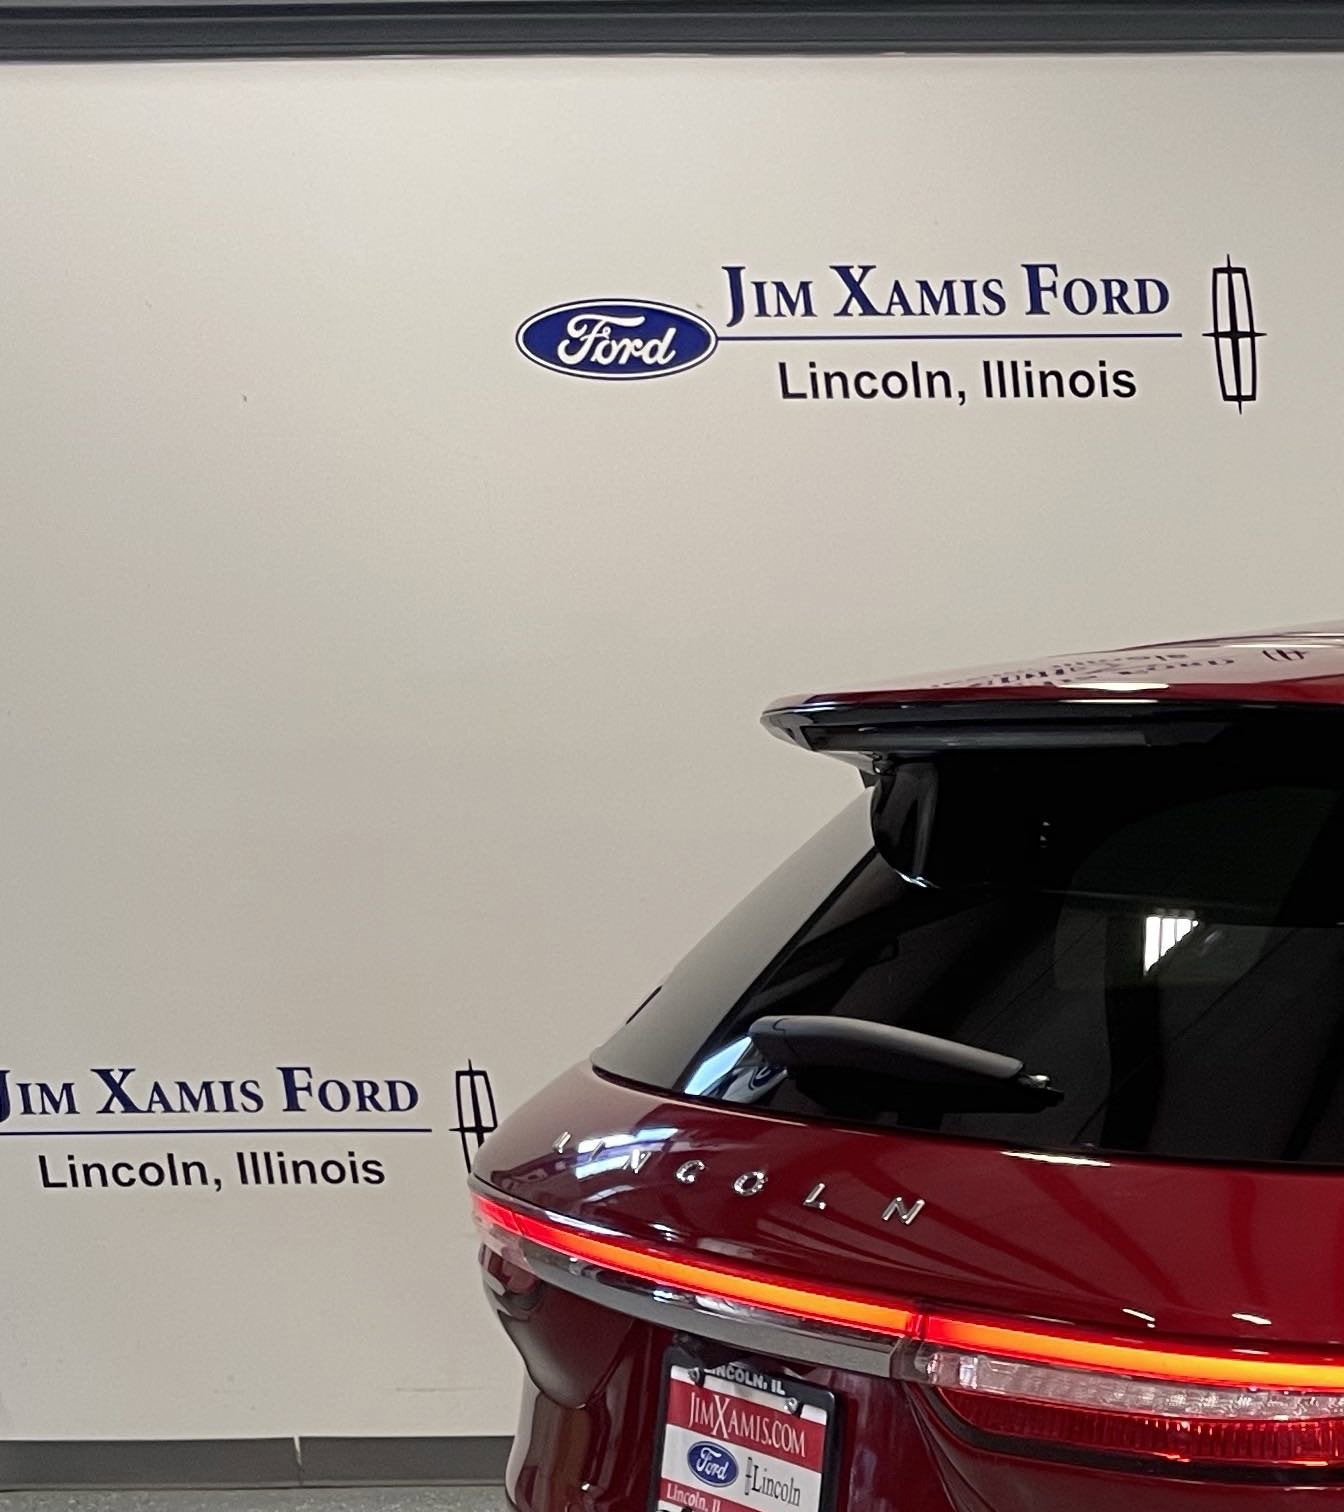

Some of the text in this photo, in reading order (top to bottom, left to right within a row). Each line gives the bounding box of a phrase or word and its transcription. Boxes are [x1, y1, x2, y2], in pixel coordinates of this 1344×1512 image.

[721, 263, 1170, 327] JIM XAMIS FORD
[778, 359, 1137, 407] Lincoln, Illinois
[90, 1068, 264, 1114] XAMIS
[275, 1066, 419, 1113] FORD
[38, 1151, 386, 1192] Lincoln, Illinois
[771, 1379, 786, 1396] IL
[688, 1392, 806, 1458] JIMXAMIS.COM
[751, 1465, 801, 1507] Lincoln
